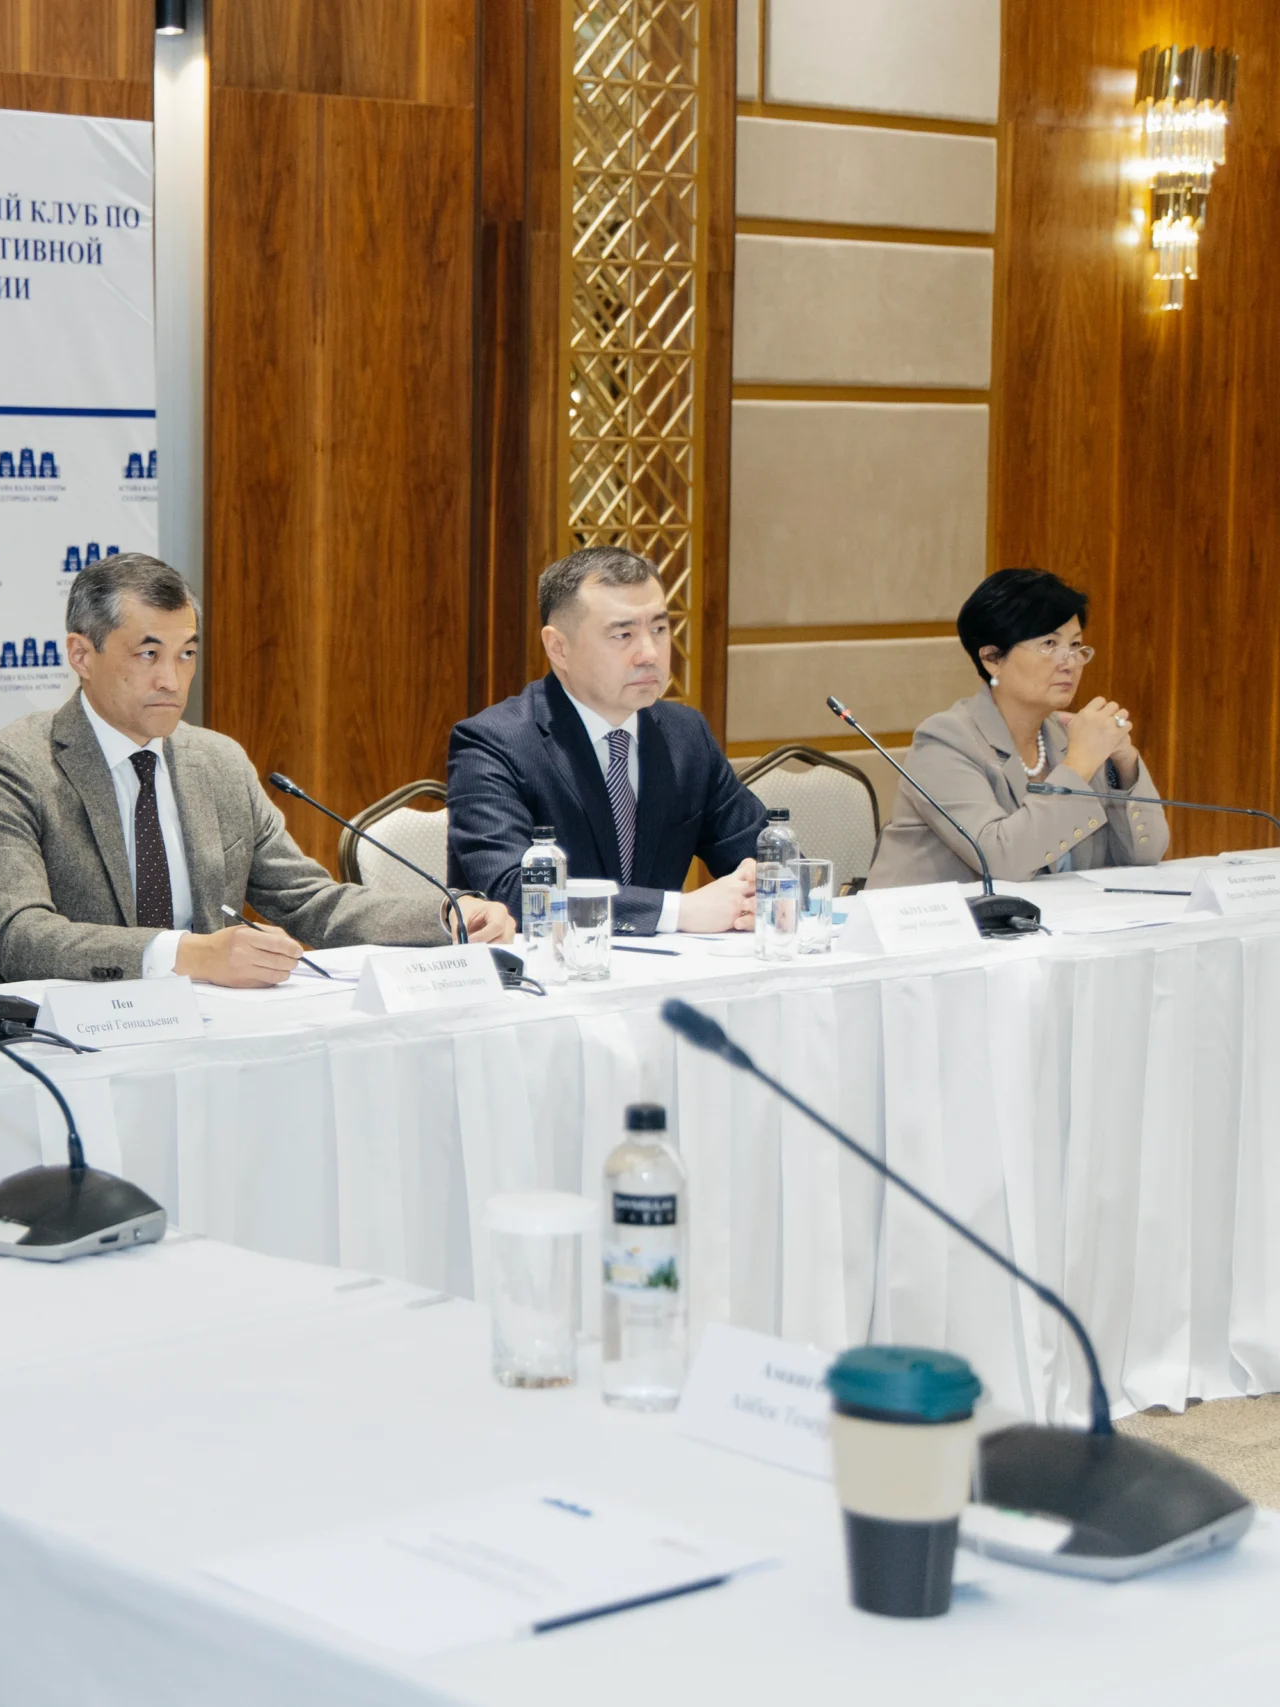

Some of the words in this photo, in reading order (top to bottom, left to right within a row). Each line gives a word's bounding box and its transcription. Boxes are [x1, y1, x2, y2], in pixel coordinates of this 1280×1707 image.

[30, 200, 99, 227] КЛУБ
[105, 204, 141, 230] ПО
[111, 999, 135, 1010] Пен
[76, 1019, 114, 1035] Сергей
